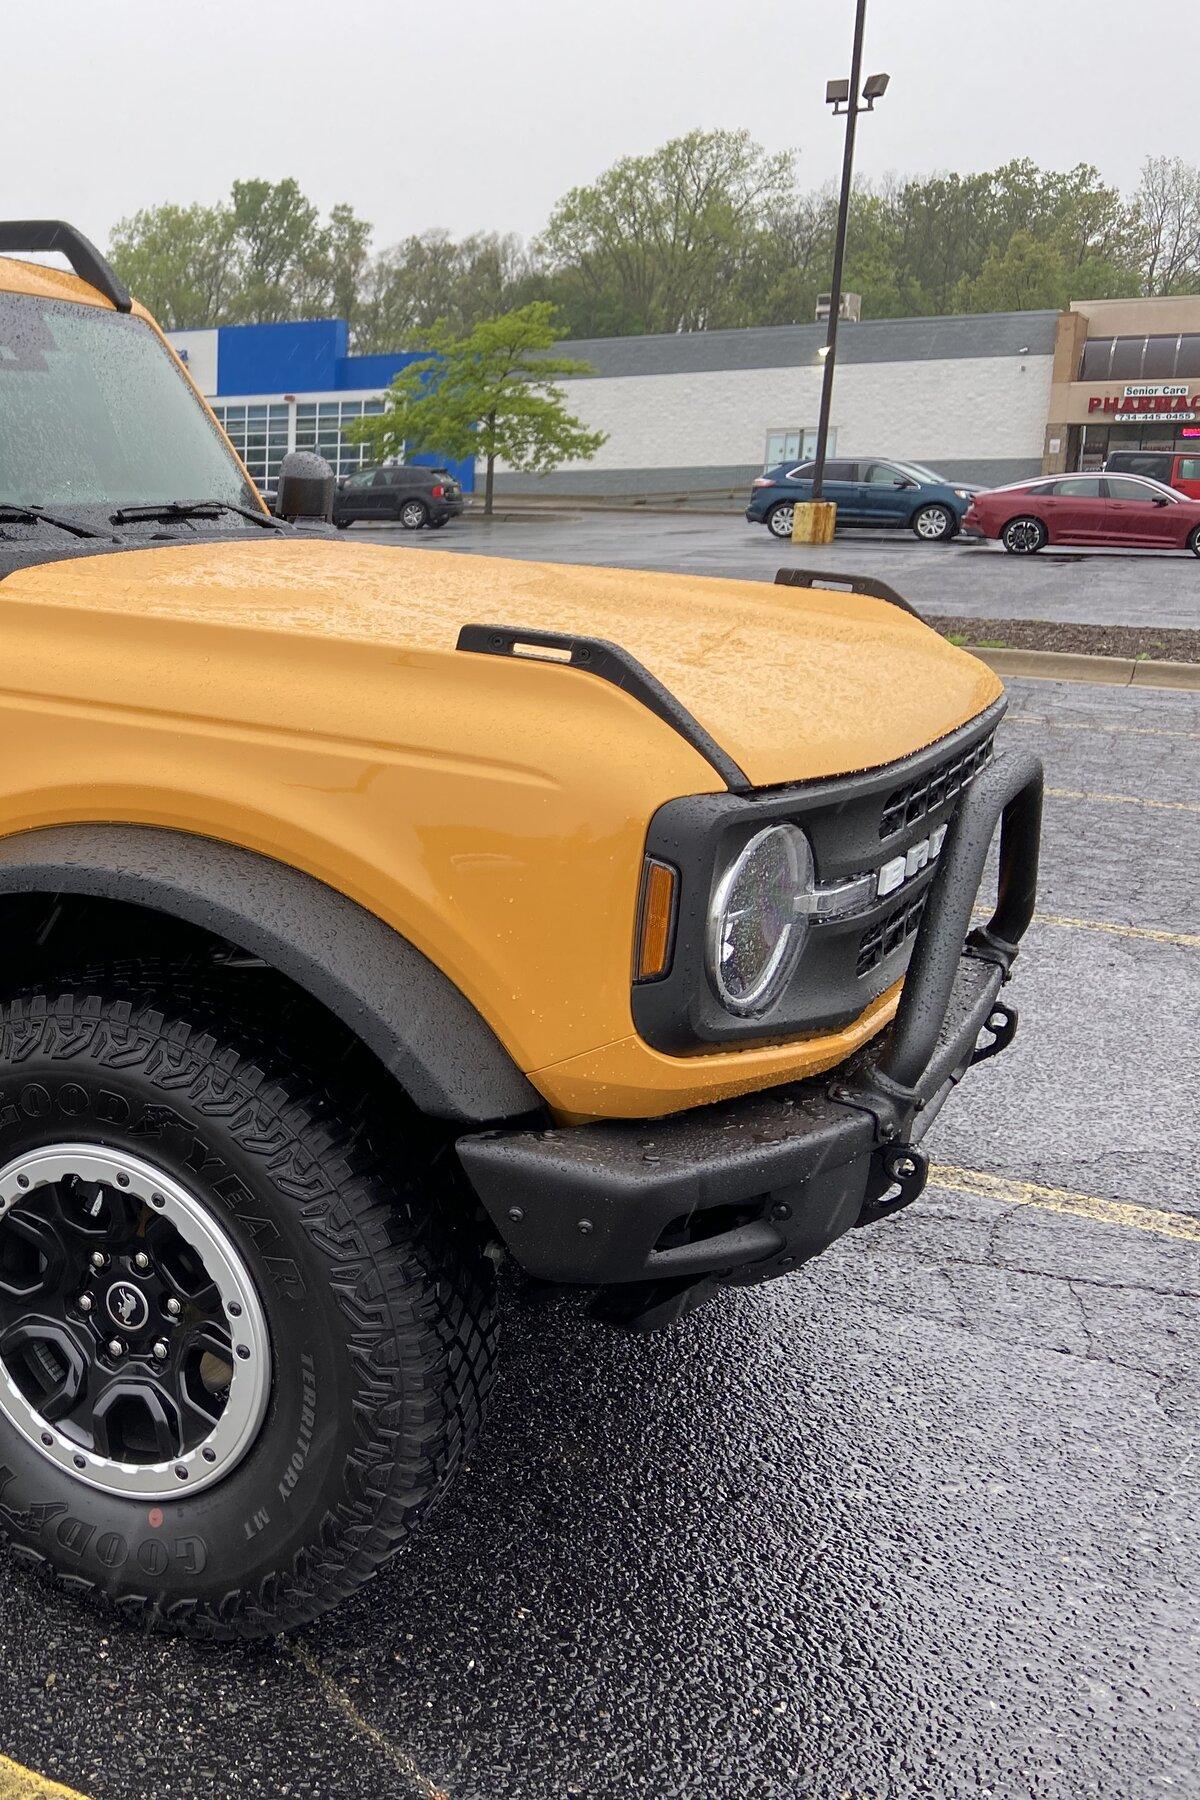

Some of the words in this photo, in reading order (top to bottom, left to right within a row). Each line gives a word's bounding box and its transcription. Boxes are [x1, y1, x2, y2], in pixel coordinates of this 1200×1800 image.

[1126, 386, 1158, 395] Senior
[1162, 386, 1187, 395] Care
[279, 1353, 316, 1503] TERRITORY
[244, 1507, 271, 1540] MT
